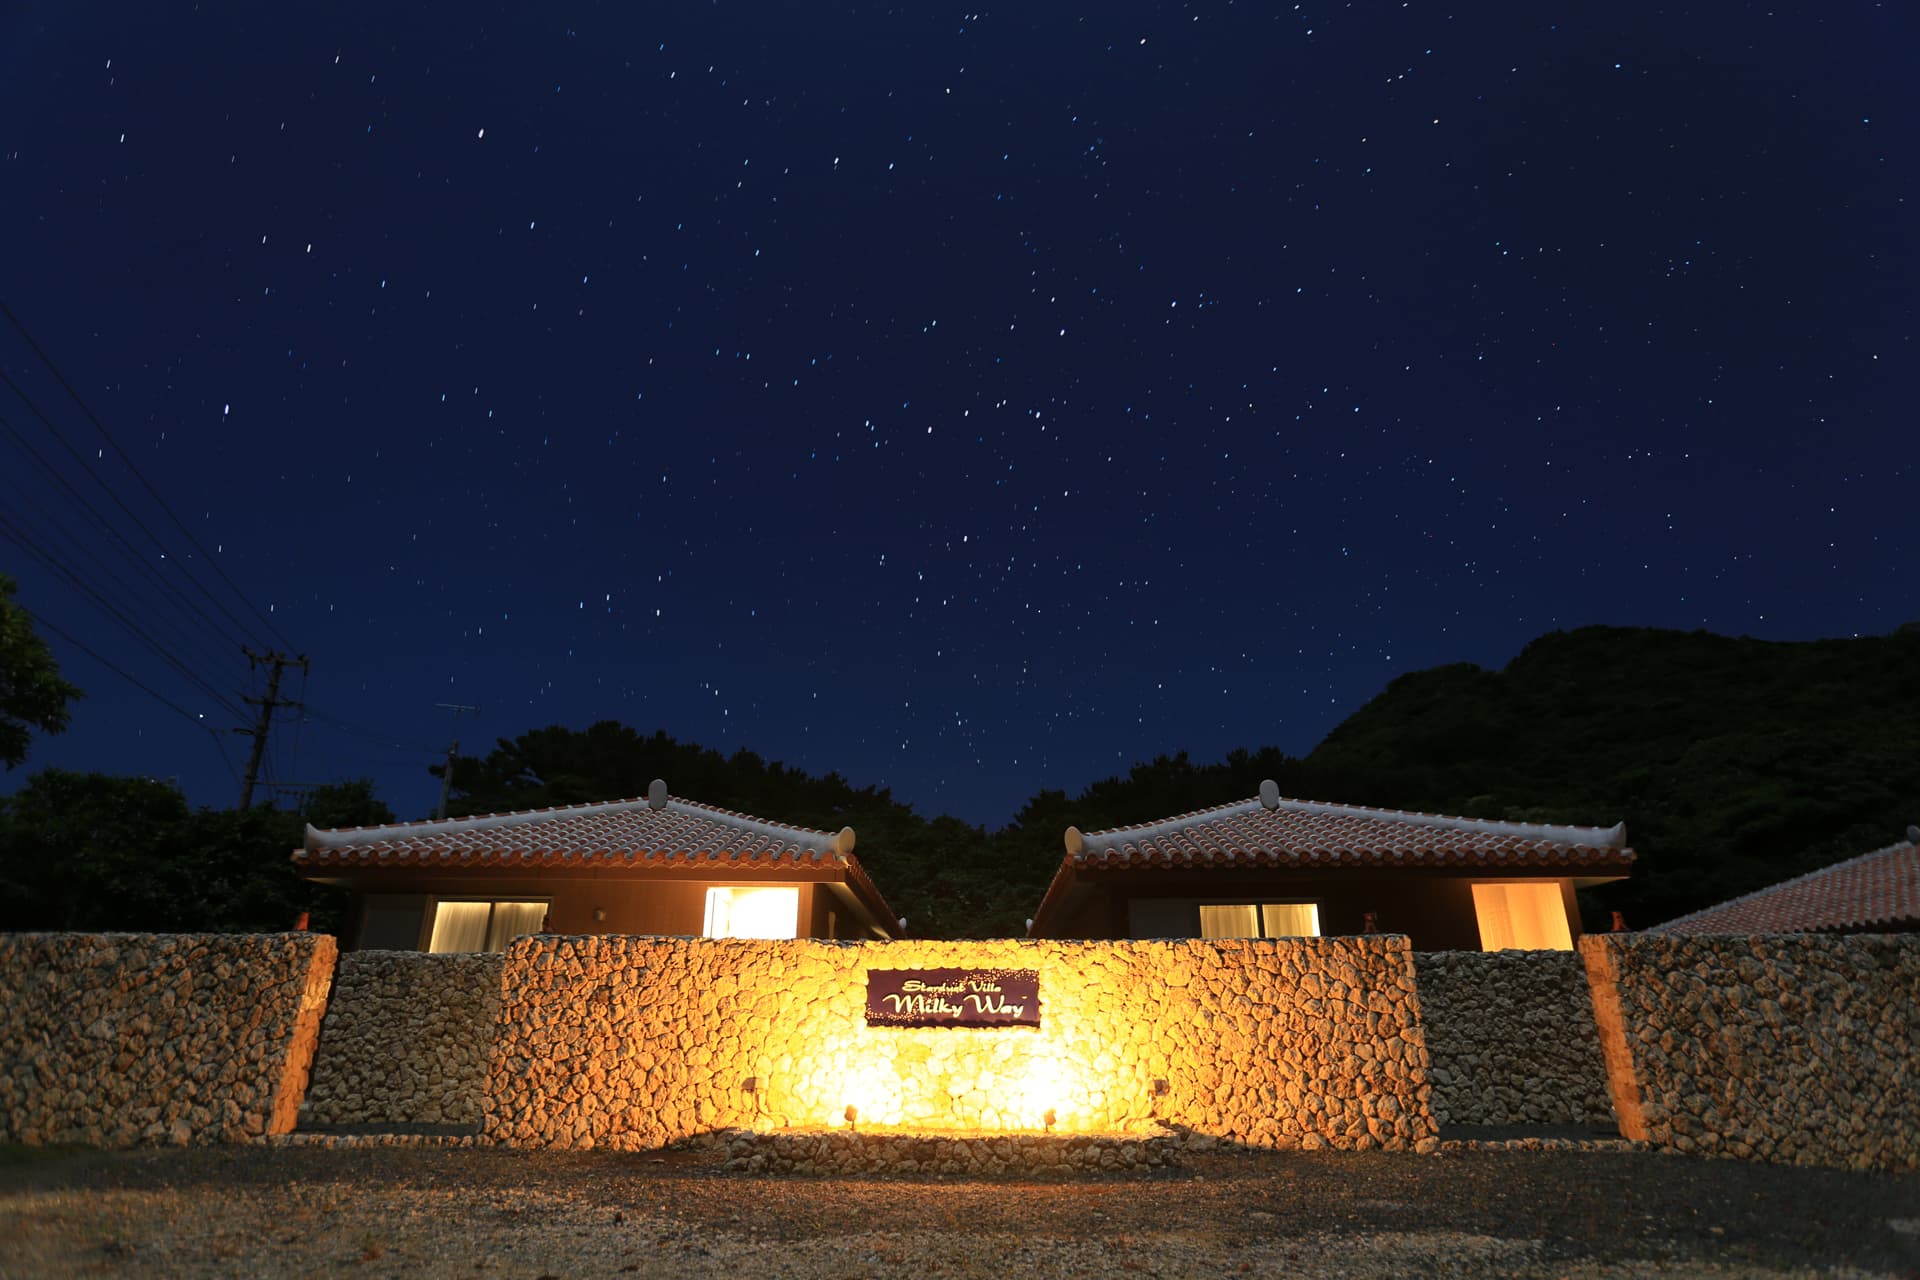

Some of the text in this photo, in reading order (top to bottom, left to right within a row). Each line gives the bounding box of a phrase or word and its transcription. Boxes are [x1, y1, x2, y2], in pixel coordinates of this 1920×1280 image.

[902, 980, 1001, 993] Stardust Villa
[882, 994, 1024, 1018] Milky Way
